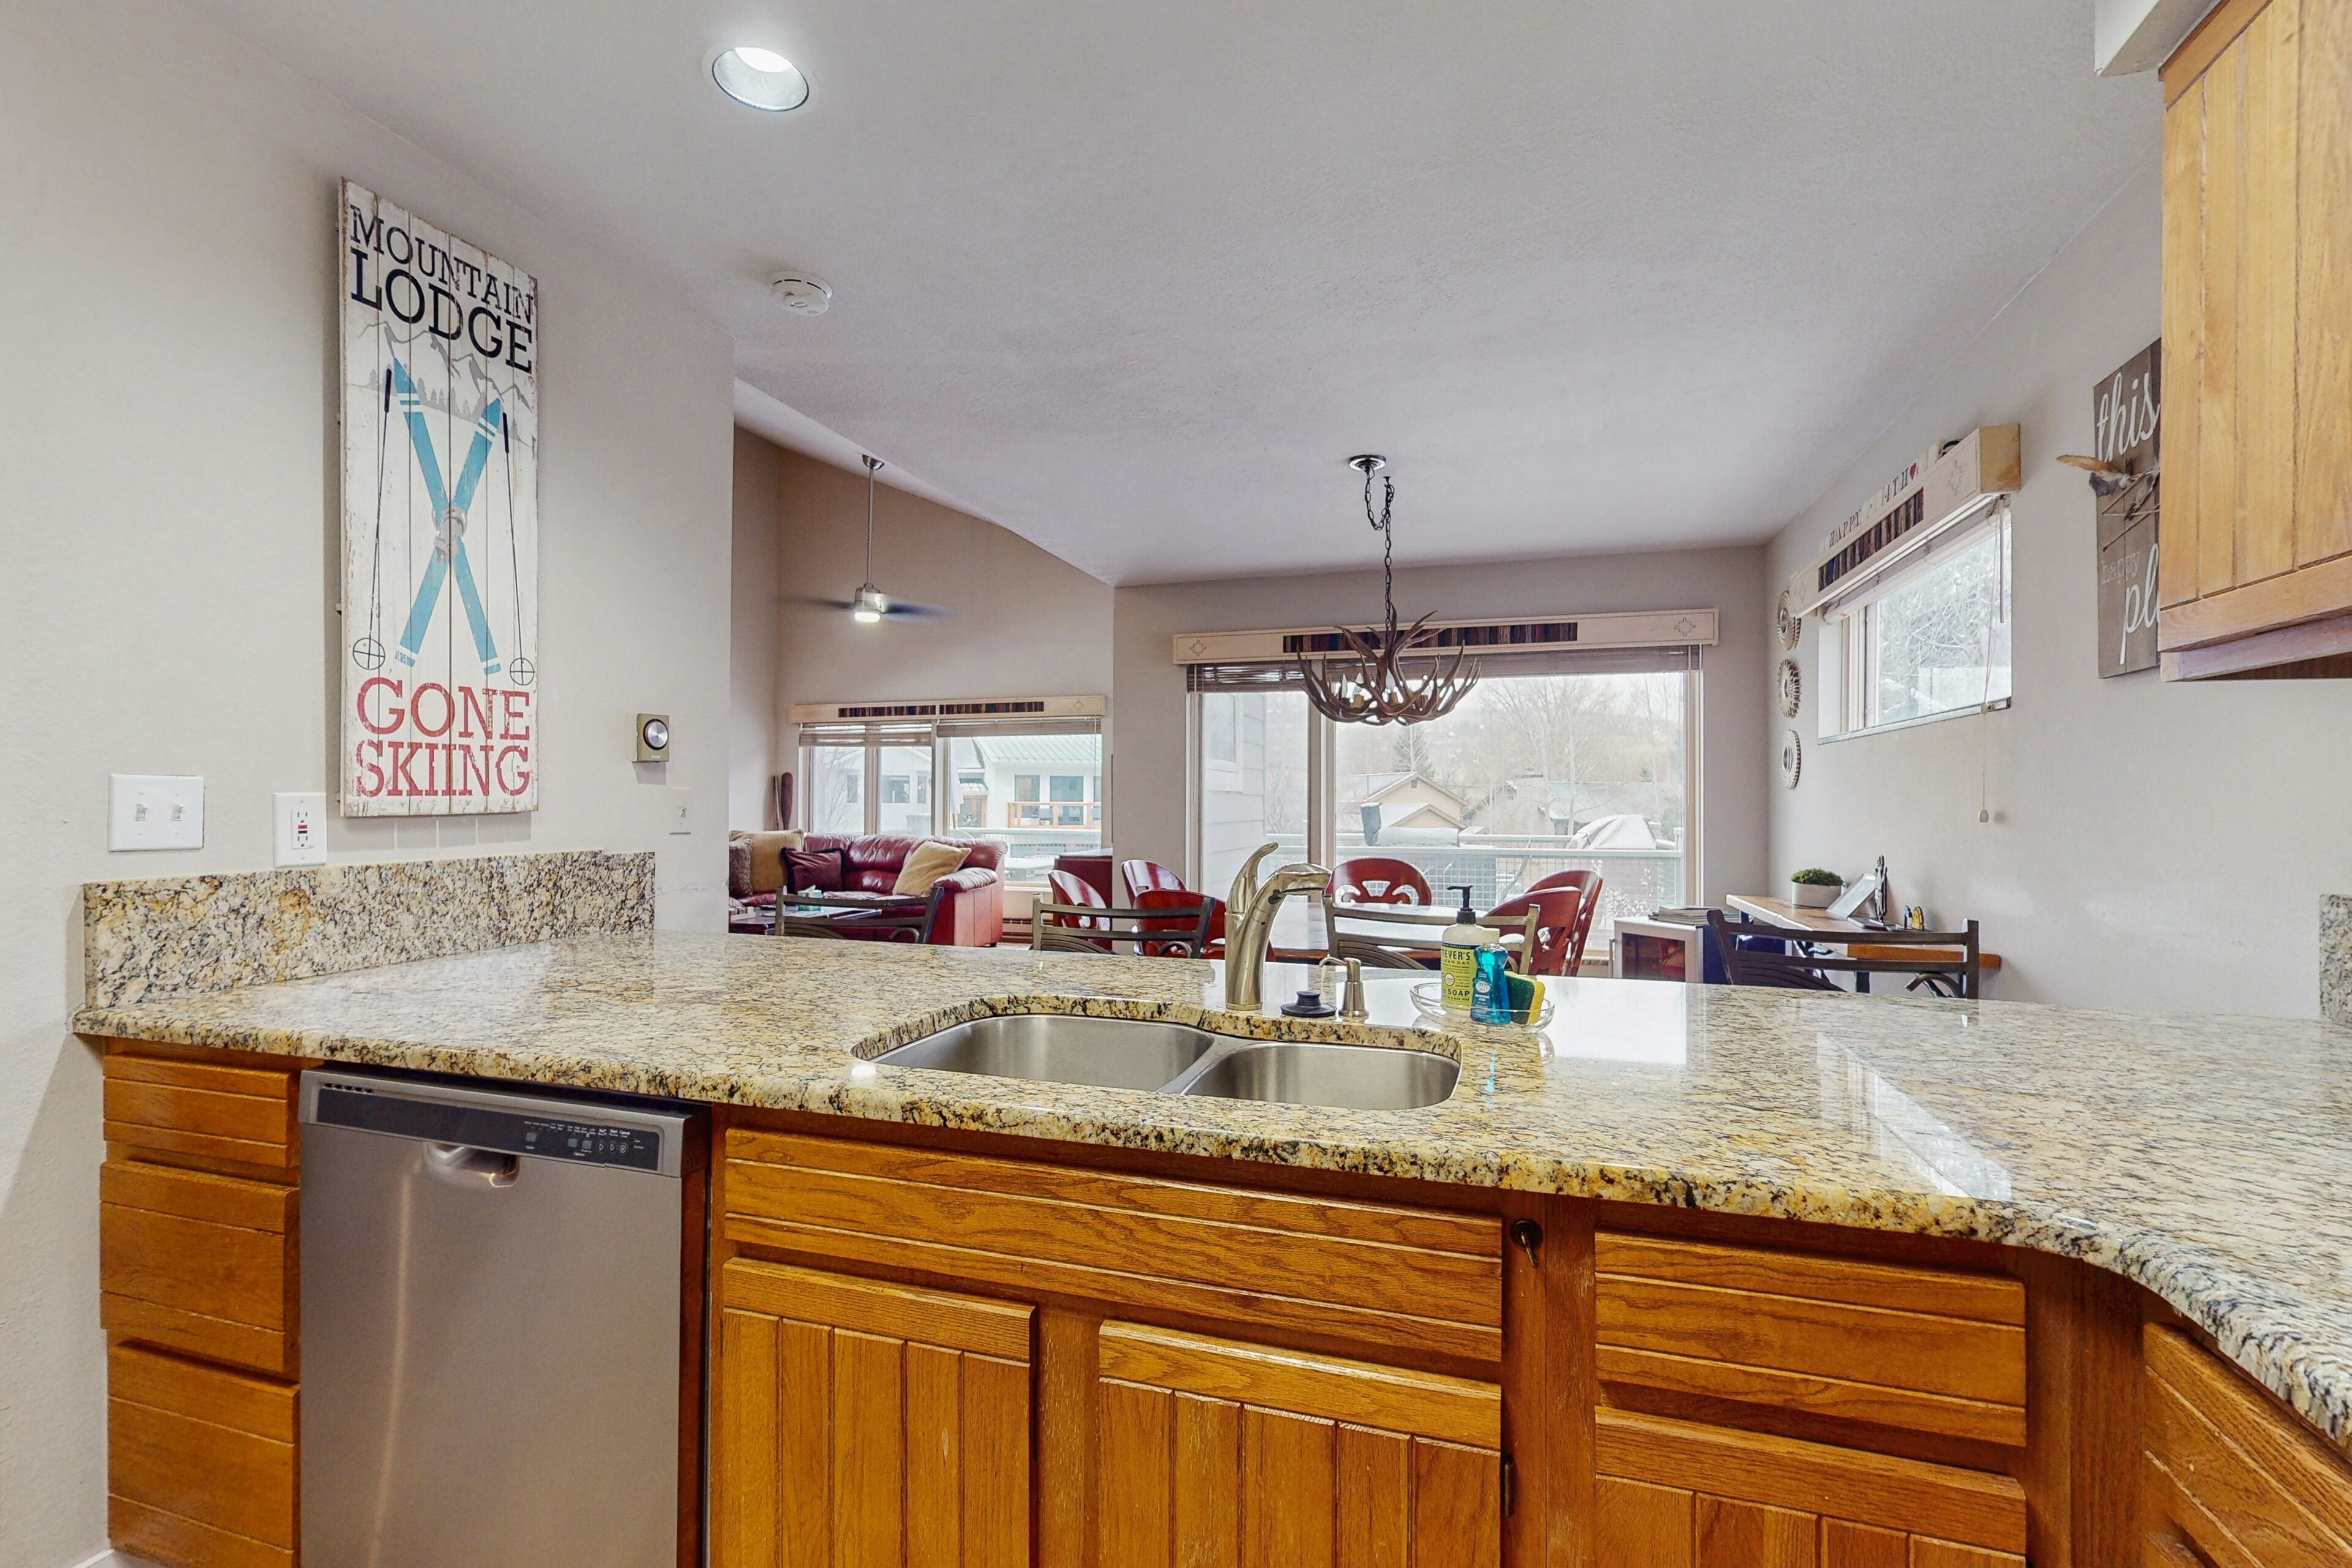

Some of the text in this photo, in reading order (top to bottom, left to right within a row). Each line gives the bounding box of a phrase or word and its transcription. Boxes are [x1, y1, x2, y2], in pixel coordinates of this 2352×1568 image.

[350, 204, 533, 325] MOUNTAIN
[350, 246, 532, 374] LODGE
[2097, 372, 2160, 463] this
[1830, 509, 1861, 548] HAPPY
[2101, 551, 2140, 584] happy
[2119, 543, 2158, 665] pl
[357, 677, 530, 741] GONE
[356, 739, 530, 797] SKIING
